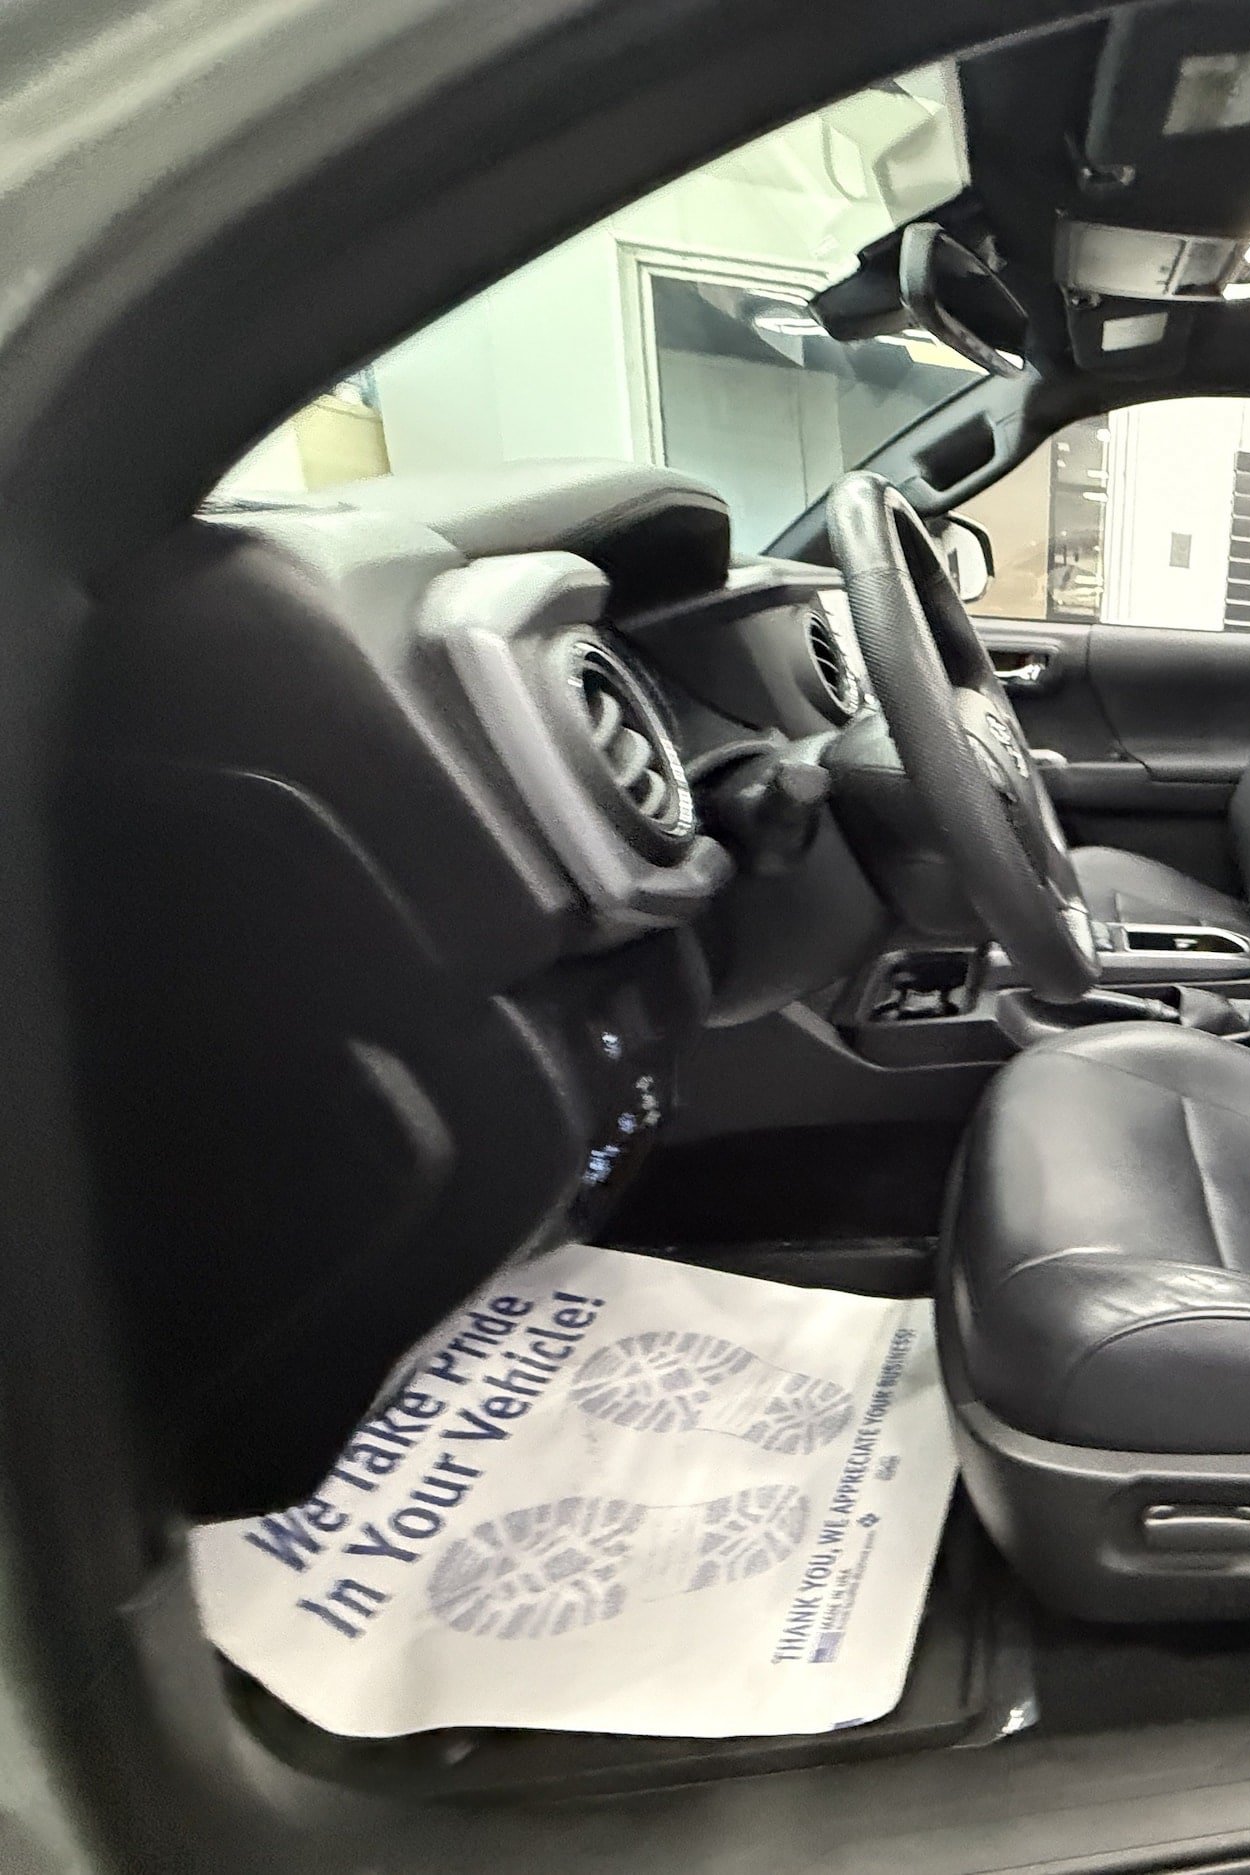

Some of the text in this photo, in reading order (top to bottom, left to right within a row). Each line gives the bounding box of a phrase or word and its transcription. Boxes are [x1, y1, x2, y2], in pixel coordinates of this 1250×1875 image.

[876, 1328, 917, 1388] BUSINESS!
[864, 1390, 893, 1425] YOUR
[296, 1291, 605, 1639] In Your Vehicle!
[830, 1427, 881, 1514] APPRECIATE
[244, 1497, 349, 1572] We
[818, 1520, 850, 1545] WE
[798, 1549, 842, 1591] YOU,
[771, 1597, 823, 1664] THANK
